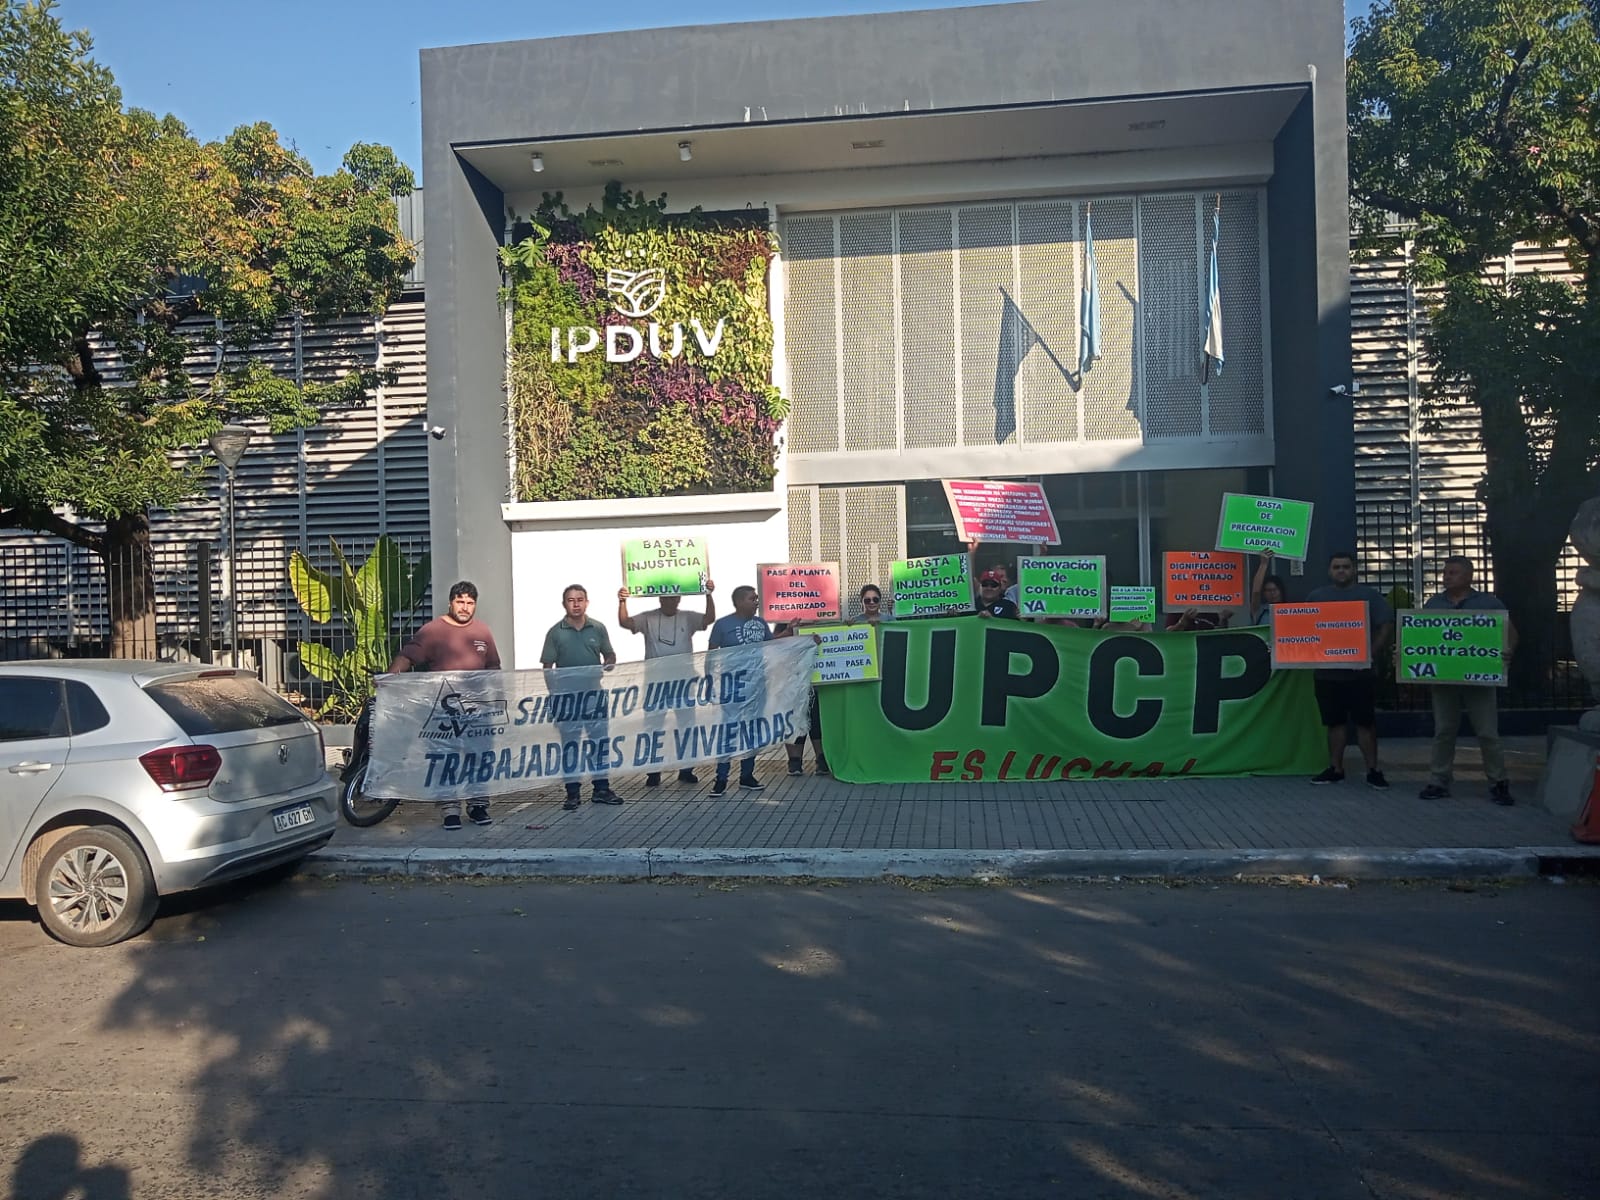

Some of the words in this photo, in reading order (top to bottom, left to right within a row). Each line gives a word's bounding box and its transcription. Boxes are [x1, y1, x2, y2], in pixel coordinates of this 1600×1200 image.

[551, 318, 725, 364] IPDUV
[1256, 500, 1282, 510] BASTA
[1260, 512, 1271, 520] DE
[643, 539, 695, 549] BASTA
[1245, 539, 1281, 548] LABORAL
[658, 549, 677, 558] DE
[627, 557, 701, 571] INJUSTICIA
[906, 557, 950, 569] BASTA
[1021, 559, 1097, 571] Renovación
[921, 568, 939, 577] DE
[1051, 572, 1067, 582] de
[896, 575, 965, 590] INJUSTICIA
[894, 589, 958, 601] Contratados
[1024, 585, 1098, 597] contratos
[769, 602, 826, 610] PRECARIZADO
[1024, 600, 1046, 613] YA
[1402, 614, 1496, 628] Renovación
[847, 631, 869, 641] AÑOS
[1442, 629, 1463, 641] de
[822, 645, 864, 654] PRECARIZADO
[1404, 646, 1499, 658] contratos
[845, 659, 864, 667] PASE
[821, 672, 850, 680] PLANTA
[1408, 663, 1436, 678] YA
[880, 627, 1273, 740] UPCP
[515, 685, 639, 726] SINDICATO
[643, 674, 714, 712] UNICO
[720, 669, 748, 705] DE
[467, 727, 505, 738] CHACO
[424, 735, 625, 788] TRABAJADORES
[633, 730, 665, 767] DE
[673, 710, 795, 760] VIVIENDAS
[930, 749, 986, 781] ES
[276, 815, 287, 830] AC
[288, 811, 301, 826] 627
